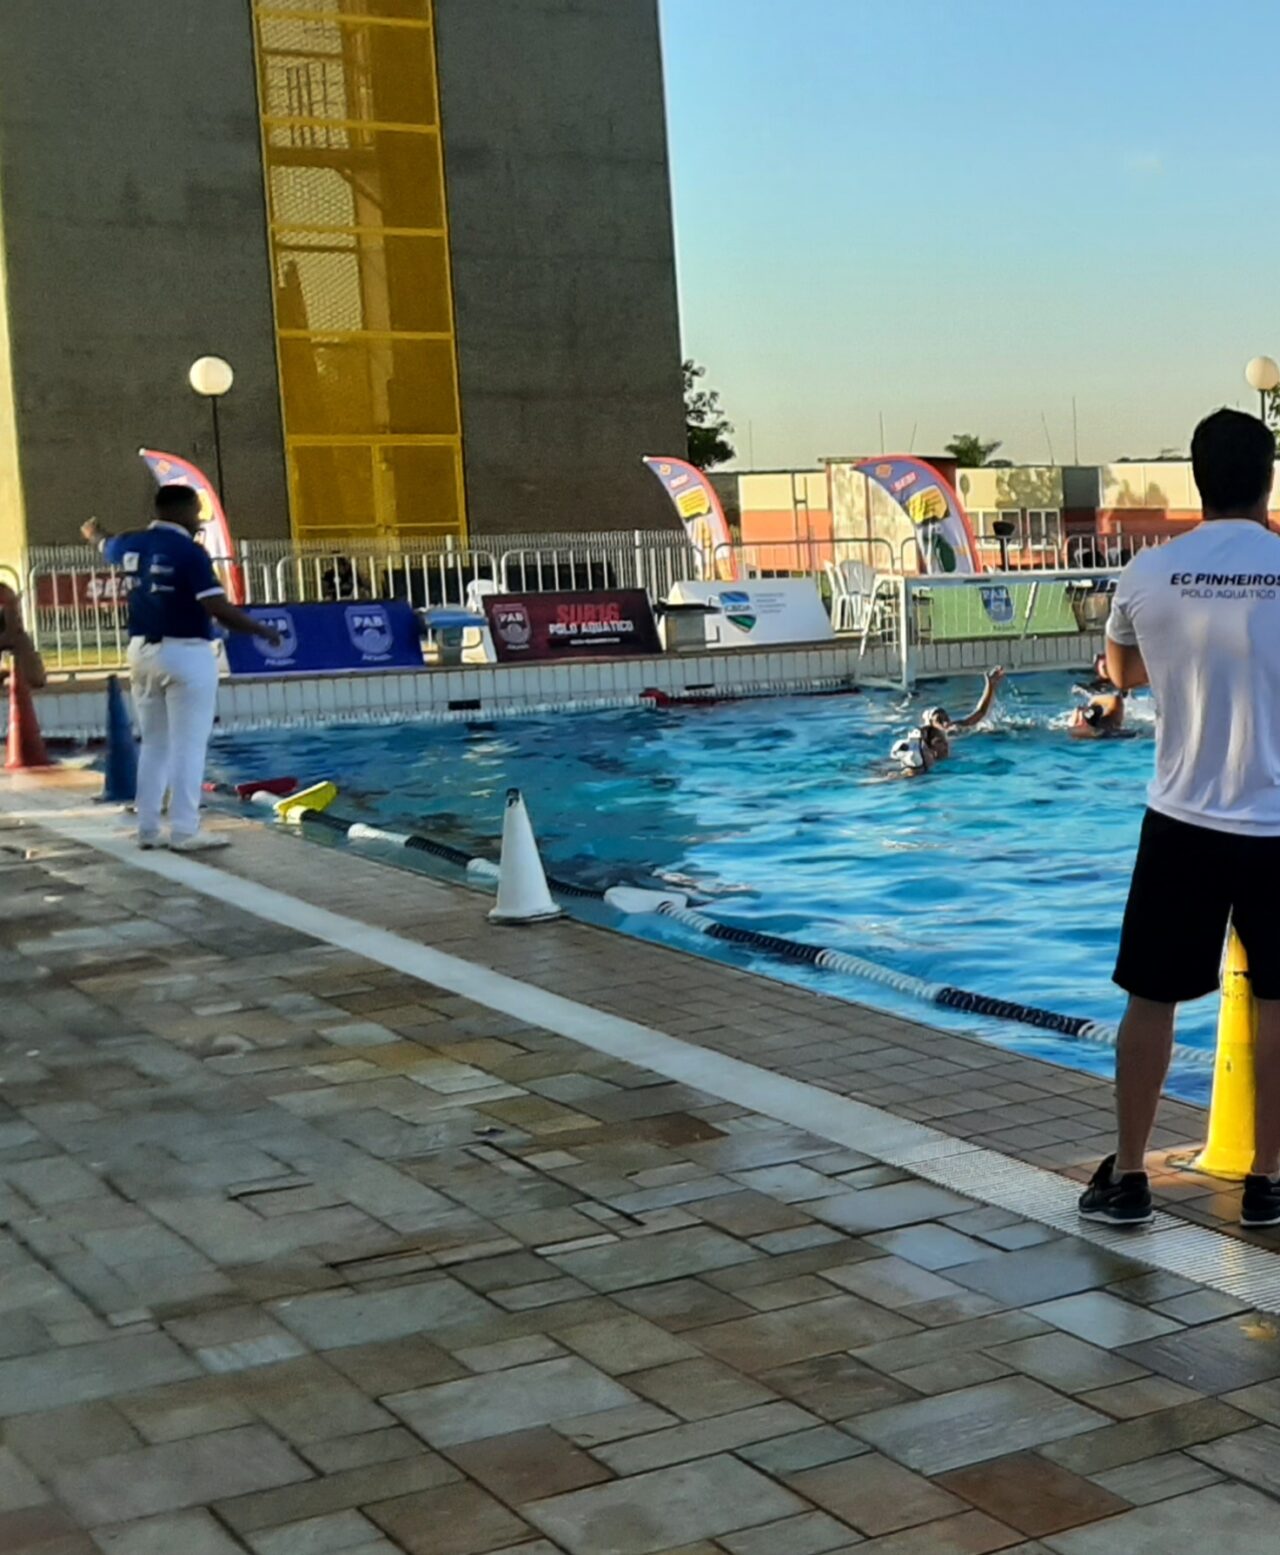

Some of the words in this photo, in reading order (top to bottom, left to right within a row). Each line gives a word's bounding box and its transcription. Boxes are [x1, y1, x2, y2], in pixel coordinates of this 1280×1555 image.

[1170, 572, 1192, 586] EC
[1181, 588, 1213, 599] POLO
[1215, 587, 1277, 600] AQUÁTICO
